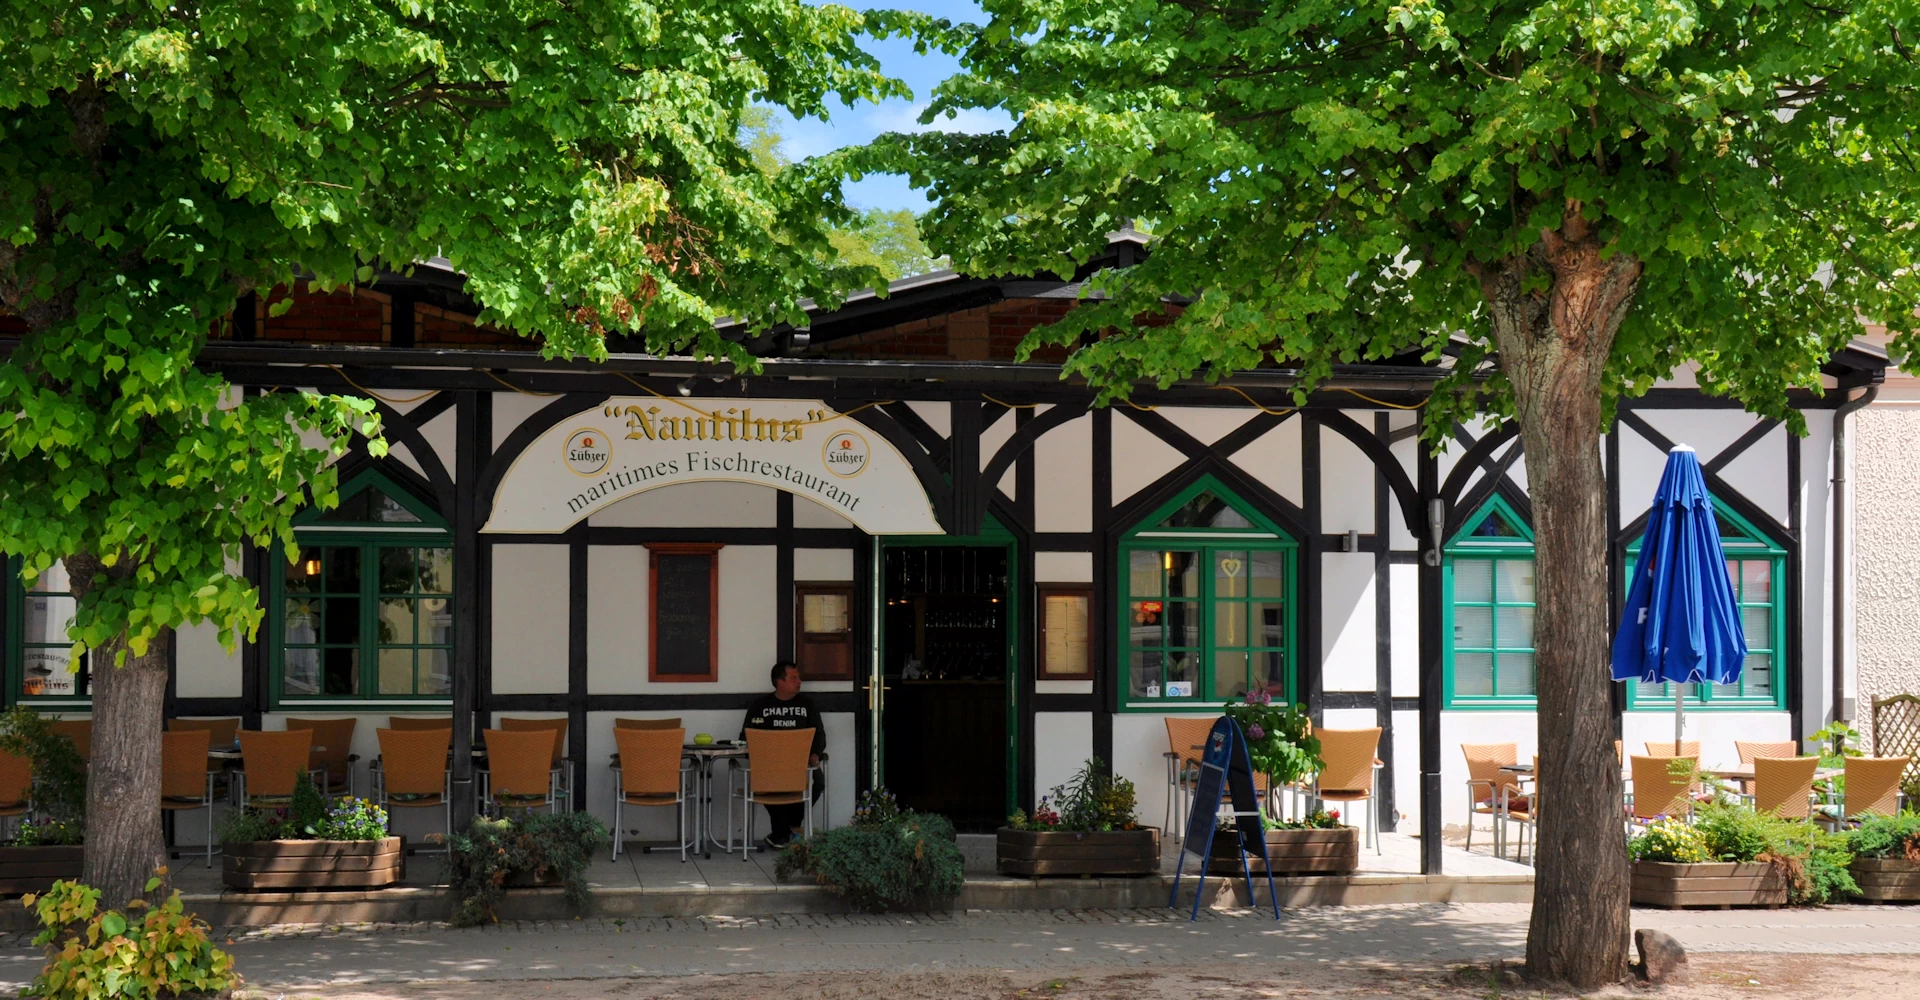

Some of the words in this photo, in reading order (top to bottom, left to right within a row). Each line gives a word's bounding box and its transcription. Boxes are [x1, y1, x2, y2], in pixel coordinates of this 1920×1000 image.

[568, 449, 607, 463] Lübzer
[828, 451, 865, 465] Lübzer
[566, 460, 679, 513] maritimes
[686, 450, 861, 512] Fischrestaurant
[762, 706, 807, 718] CHAPTER
[773, 719, 796, 727] DENIM
